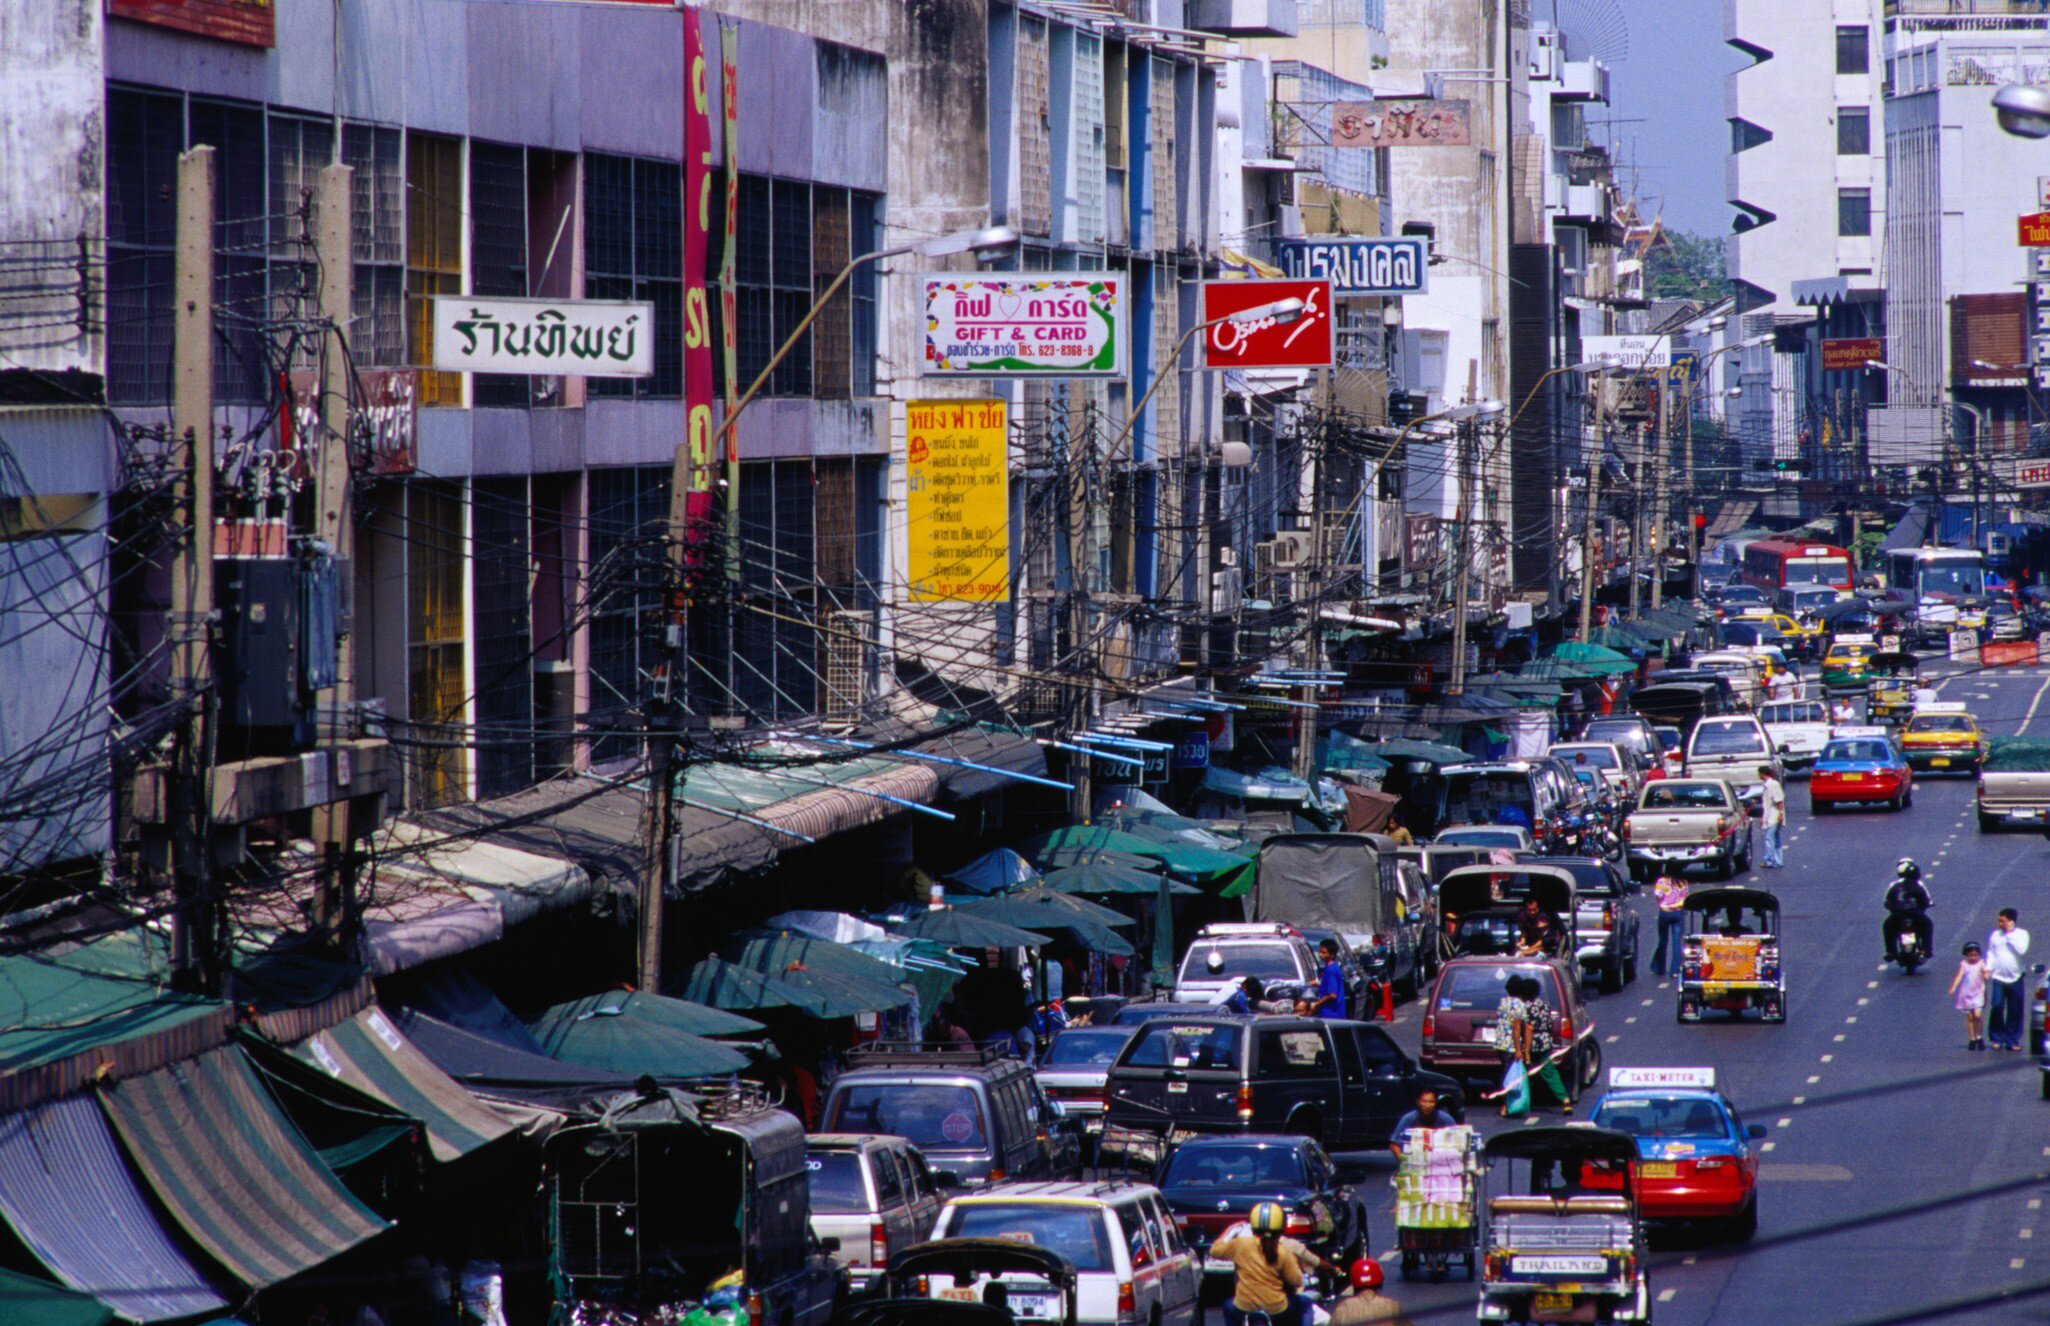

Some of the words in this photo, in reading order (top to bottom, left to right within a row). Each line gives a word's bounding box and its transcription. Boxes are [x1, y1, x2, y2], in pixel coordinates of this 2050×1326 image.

[1028, 292, 1087, 319] การ์ด
[451, 307, 640, 362] ร้านทิพย์
[955, 327, 1004, 341] GIFT
[1010, 326, 1026, 341] &
[1034, 326, 1088, 341] CARD
[1038, 344, 1094, 357] 623-8368-9
[1631, 1072, 1696, 1083] TAXI-METER
[945, 1123, 970, 1133] STOP
[1520, 1260, 1603, 1271] THAILAND
